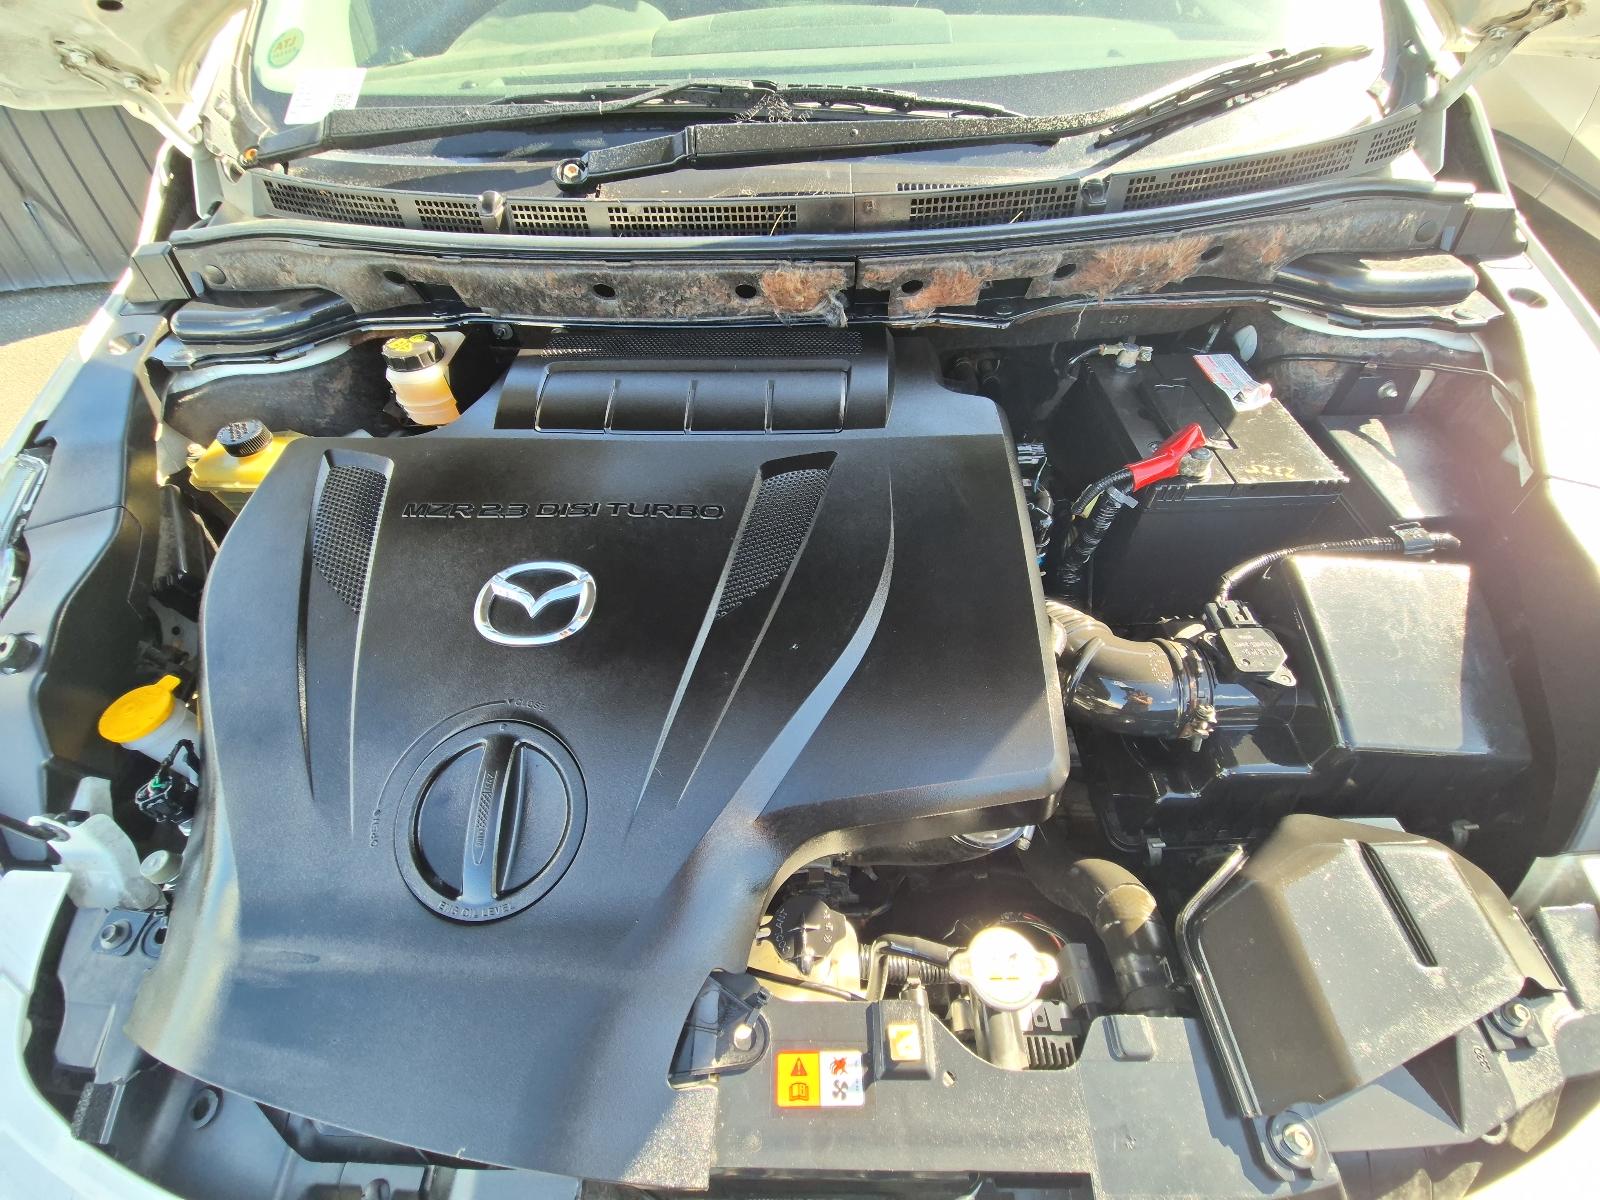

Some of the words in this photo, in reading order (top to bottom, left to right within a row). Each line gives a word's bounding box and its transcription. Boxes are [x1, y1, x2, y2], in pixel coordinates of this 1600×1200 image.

[401, 502, 474, 519] MZR
[535, 502, 601, 519] DISI
[606, 502, 725, 519] TURBO
[514, 698, 546, 713] CLOSE
[369, 817, 380, 848] OPEN
[437, 900, 459, 916] ENG
[461, 907, 479, 919] OIL
[481, 903, 515, 918] LEVEL
